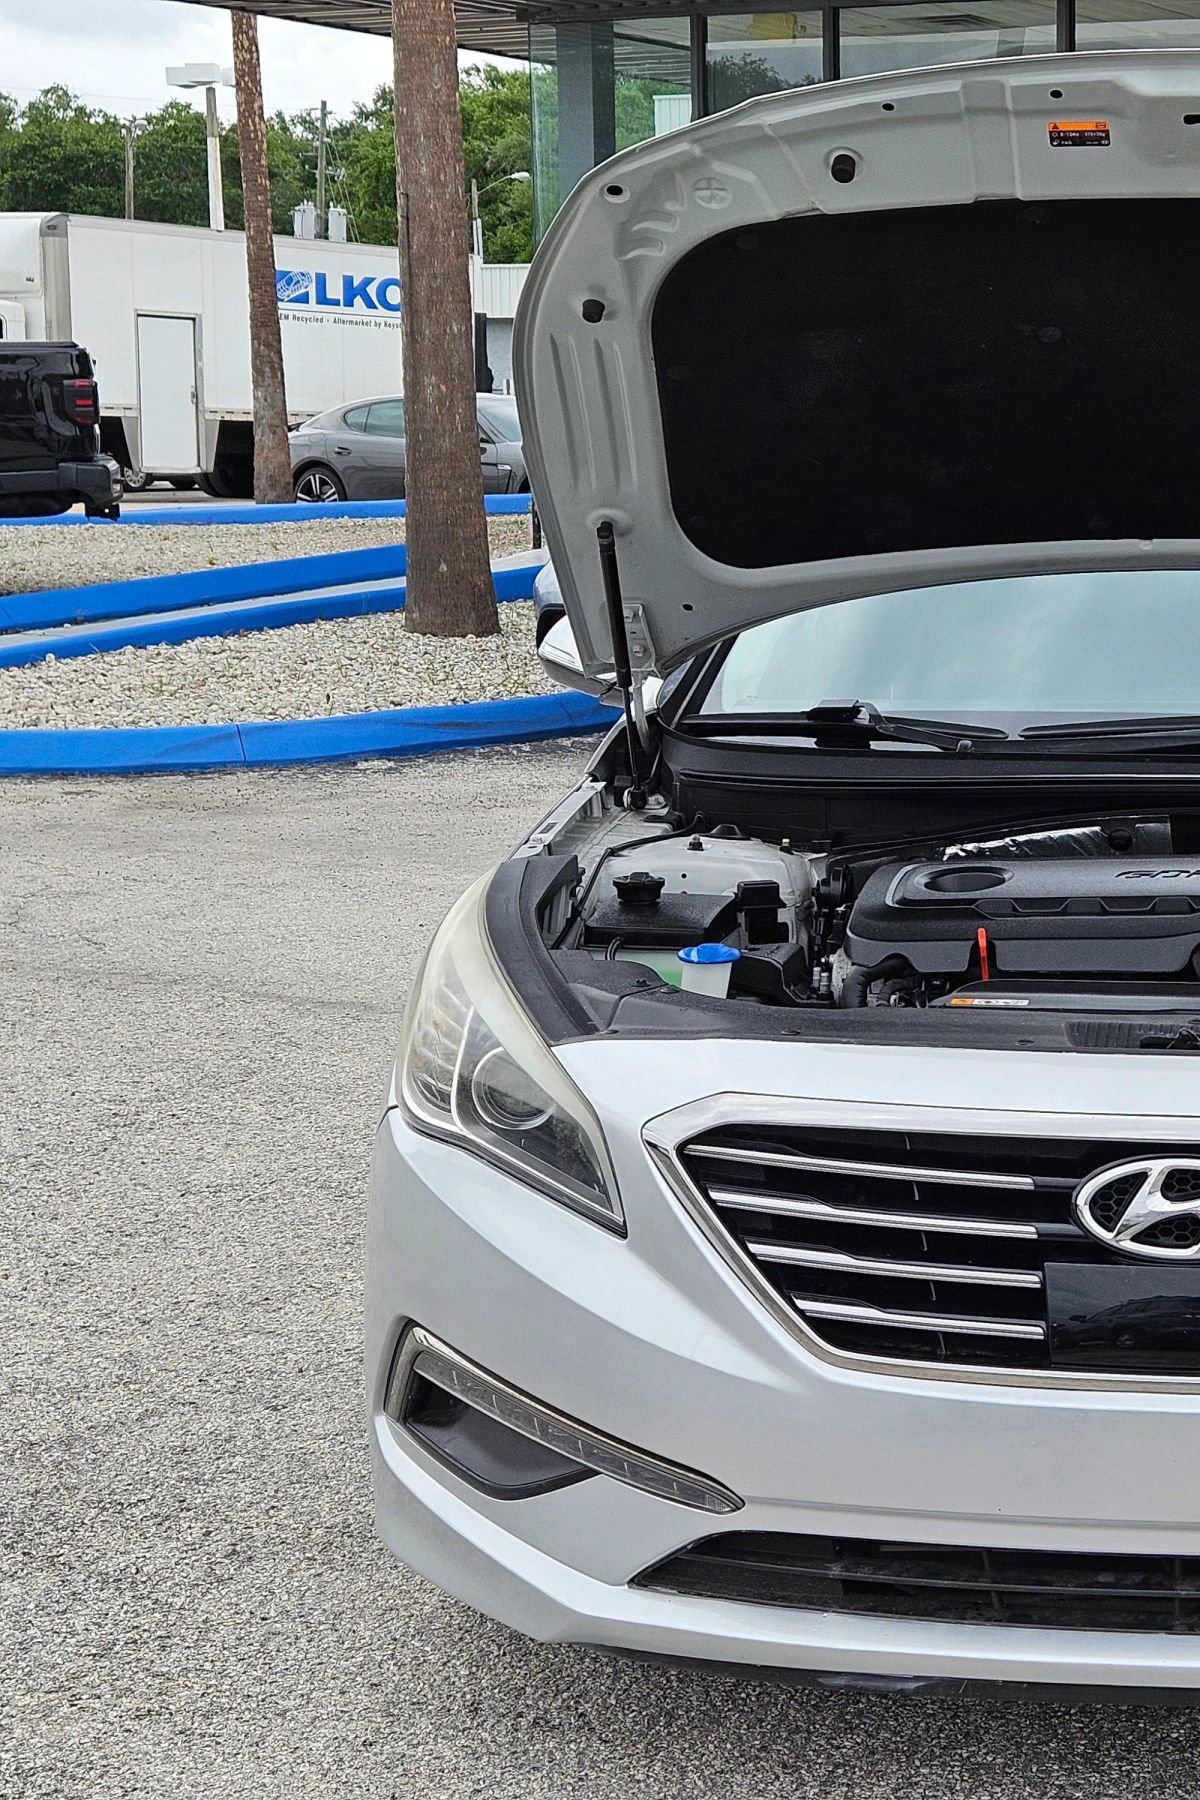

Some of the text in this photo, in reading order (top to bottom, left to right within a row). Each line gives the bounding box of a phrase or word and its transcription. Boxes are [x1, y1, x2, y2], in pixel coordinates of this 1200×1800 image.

[292, 314, 324, 324] Recycled
[332, 317, 372, 327] Aftermarket
[374, 319, 381, 329] by
